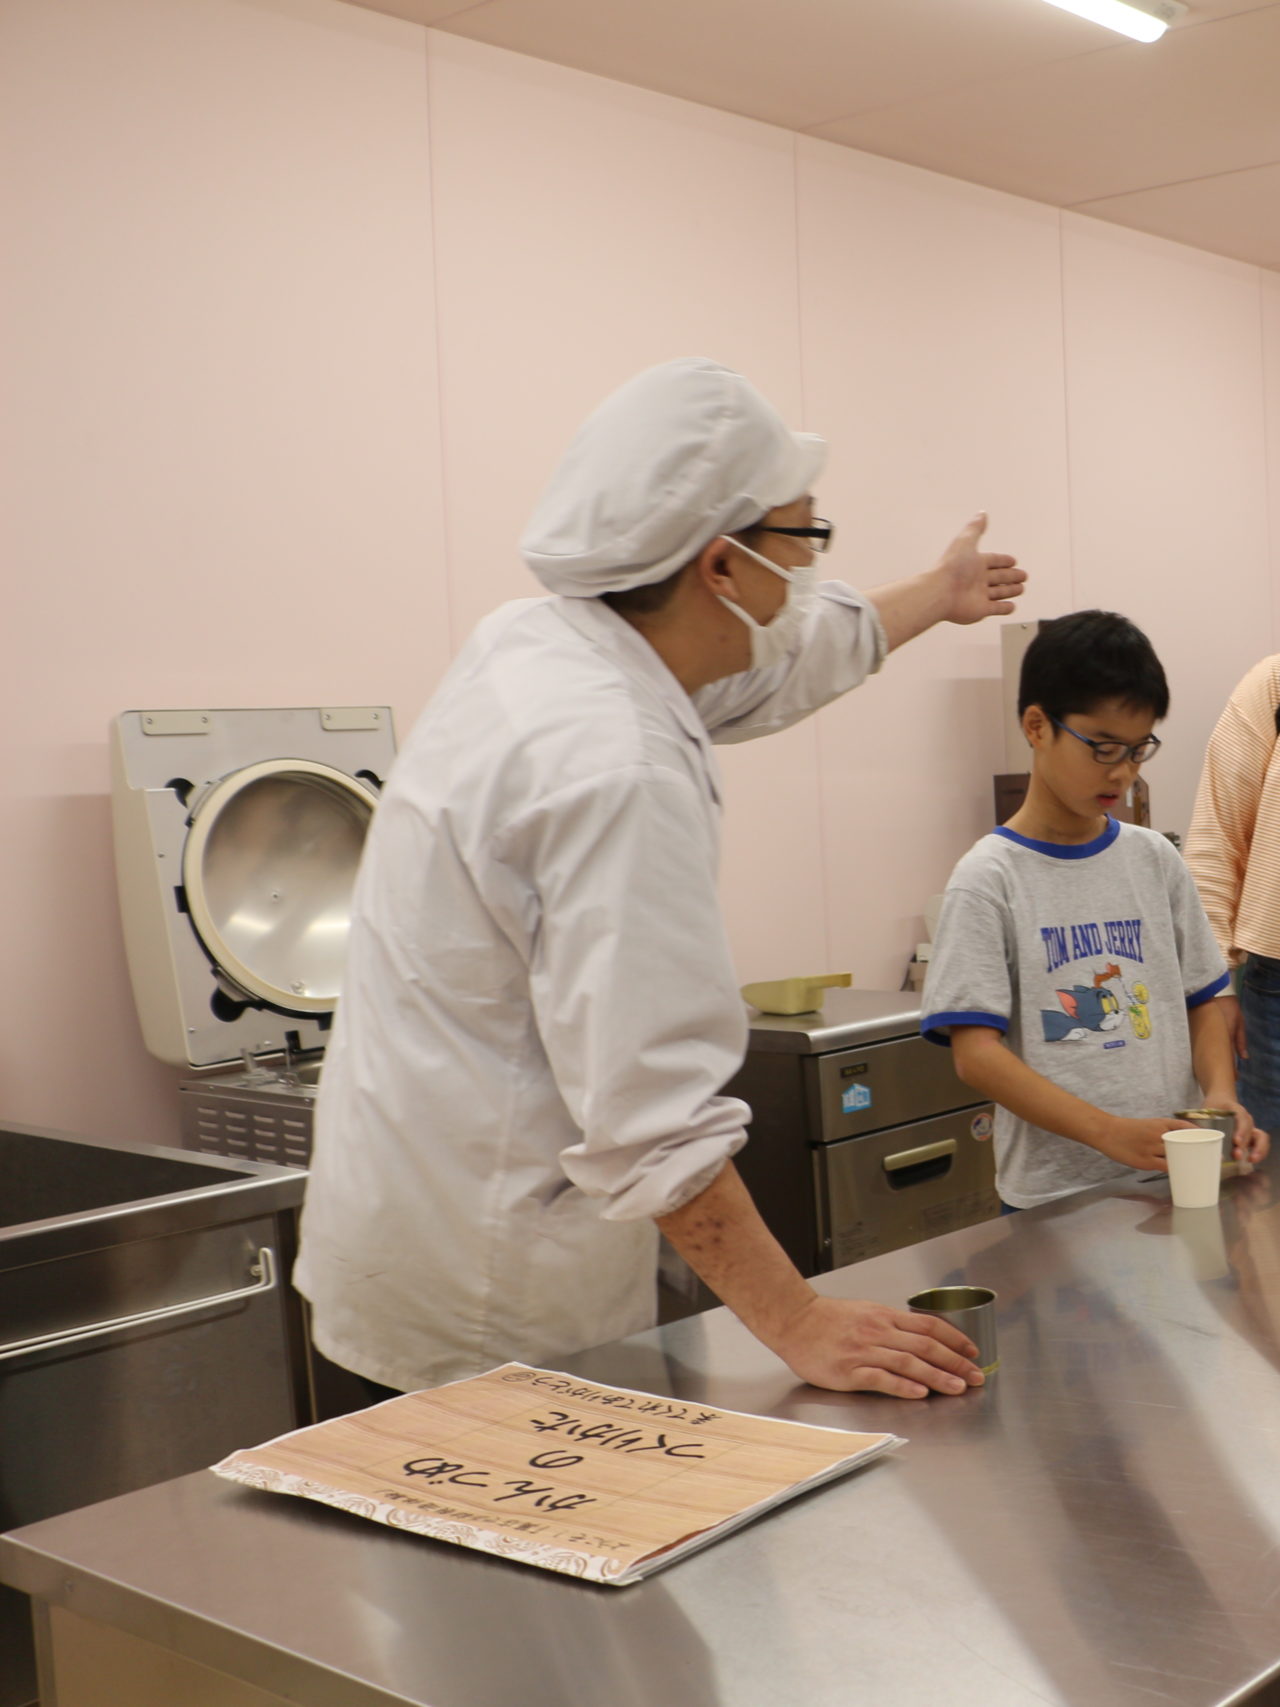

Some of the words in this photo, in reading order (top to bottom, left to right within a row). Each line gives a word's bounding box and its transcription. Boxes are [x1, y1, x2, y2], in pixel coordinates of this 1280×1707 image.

[1040, 926, 1070, 974] TOM
[1070, 922, 1103, 961] AND
[1104, 919, 1144, 964] JERRY
[529, 1411, 706, 1459] つくりかた
[529, 1449, 585, 1469] の
[402, 1457, 598, 1513] かんづめ
